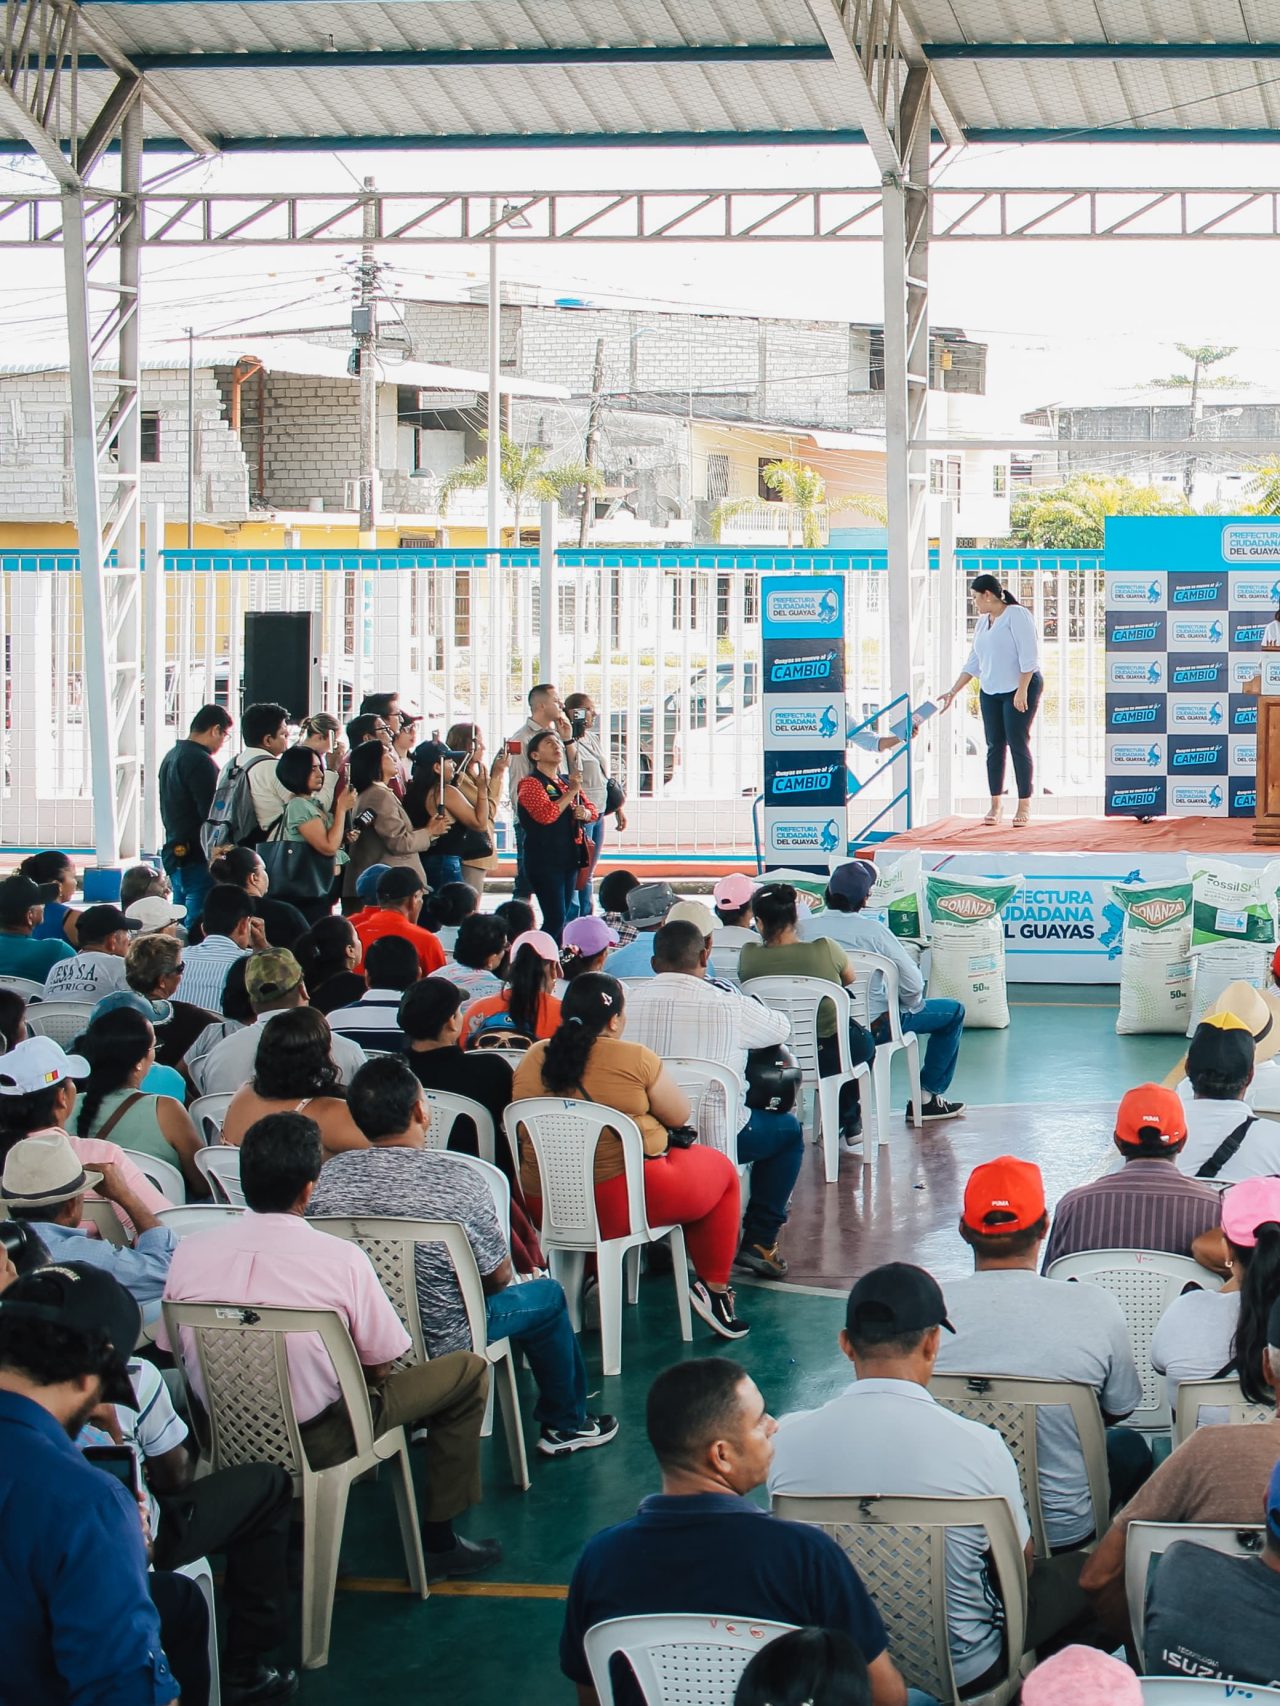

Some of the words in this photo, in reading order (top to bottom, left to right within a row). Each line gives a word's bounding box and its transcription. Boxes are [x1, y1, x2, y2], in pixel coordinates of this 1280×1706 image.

[1175, 590, 1215, 601] CAMBIO
[1115, 630, 1154, 641] CAMBIO
[1237, 630, 1264, 641] CAMB
[774, 664, 826, 678] CAMBIO
[1175, 671, 1215, 682] CAMBIO
[1115, 711, 1154, 722] CAMBIO
[1175, 753, 1215, 764] CAMBIO
[776, 776, 828, 791] CAMBIO
[1114, 793, 1153, 805] CAMBIO
[1009, 890, 1093, 904] FECTURA
[940, 900, 992, 915] BONANZA
[1002, 906, 1094, 921] UDADANA
[1133, 902, 1182, 921] BONANZA
[1020, 924, 1094, 939] GUAYAS
[1163, 1649, 1234, 1680] ISUZ
